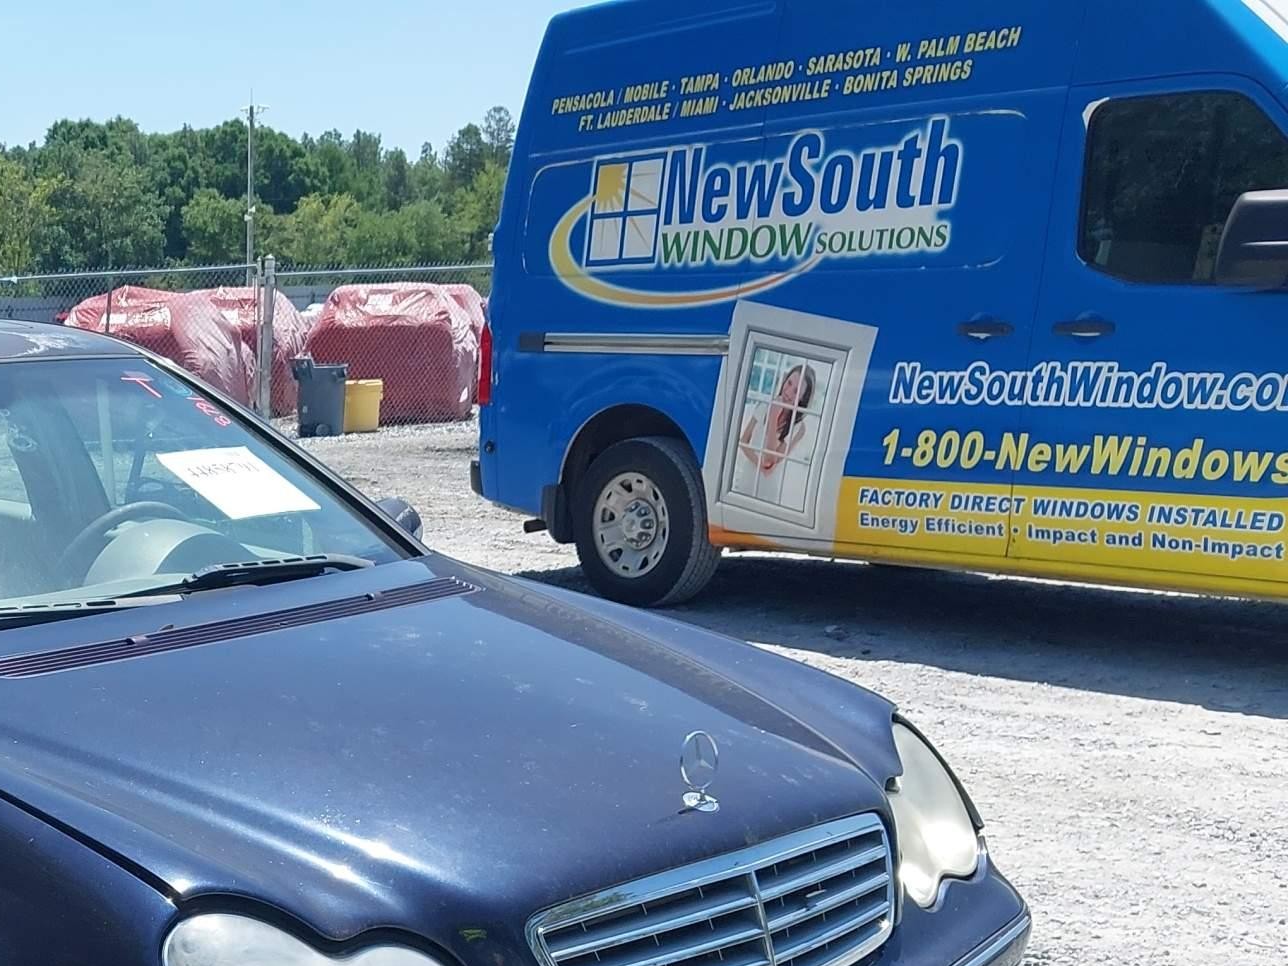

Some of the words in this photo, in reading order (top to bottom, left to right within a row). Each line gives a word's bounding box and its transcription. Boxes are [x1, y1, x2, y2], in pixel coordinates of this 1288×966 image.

[552, 89, 615, 115] PENSACOLA
[624, 80, 669, 103] MOBILE
[680, 72, 720, 95] TAMPA
[731, 60, 795, 87] ORLANDO
[806, 47, 881, 76] SARASOTA
[895, 42, 912, 63] W.
[917, 35, 961, 60] PALM
[963, 26, 1022, 53] BEACH
[578, 114, 593, 132] FT.
[597, 102, 671, 129] LAUDERDALE
[680, 95, 719, 118] MIAMI
[729, 79, 832, 111] JACKSONVILLE
[842, 69, 898, 95] BONITA
[903, 59, 973, 86] SPRINGS
[663, 118, 961, 226] NewSouth
[661, 221, 813, 264] WINDOW
[816, 223, 948, 254] SOLUTIONS
[859, 488, 943, 510] FACTORY
[950, 493, 1026, 514] DIRECT
[1033, 498, 1140, 522] WINDOWS
[1148, 505, 1284, 531] INSTALLED
[860, 513, 918, 534] Energy
[925, 517, 1004, 537] Efficient
[1027, 524, 1097, 544] Impact
[1106, 532, 1143, 547] and
[1152, 533, 1284, 559] Non-Impact
